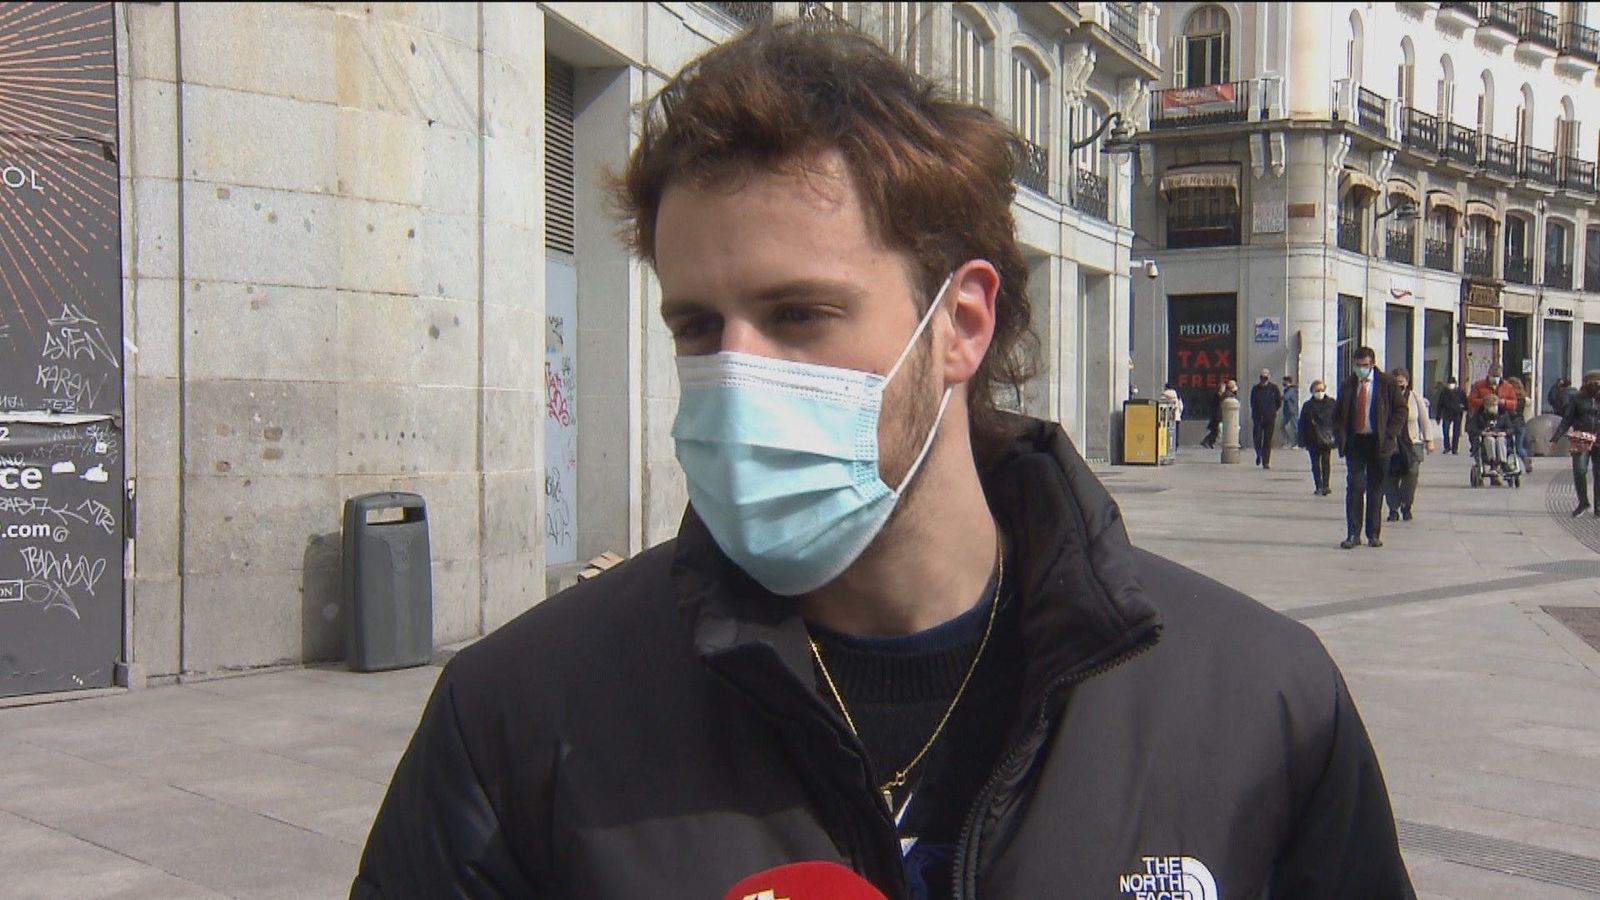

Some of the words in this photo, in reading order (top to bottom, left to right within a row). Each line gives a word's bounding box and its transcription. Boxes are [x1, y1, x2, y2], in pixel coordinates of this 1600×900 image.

[1179, 323, 1230, 335] PRIMOR
[1178, 349, 1230, 368] TAX
[1141, 856, 1181, 874] THE
[1119, 873, 1182, 893] NORTH
